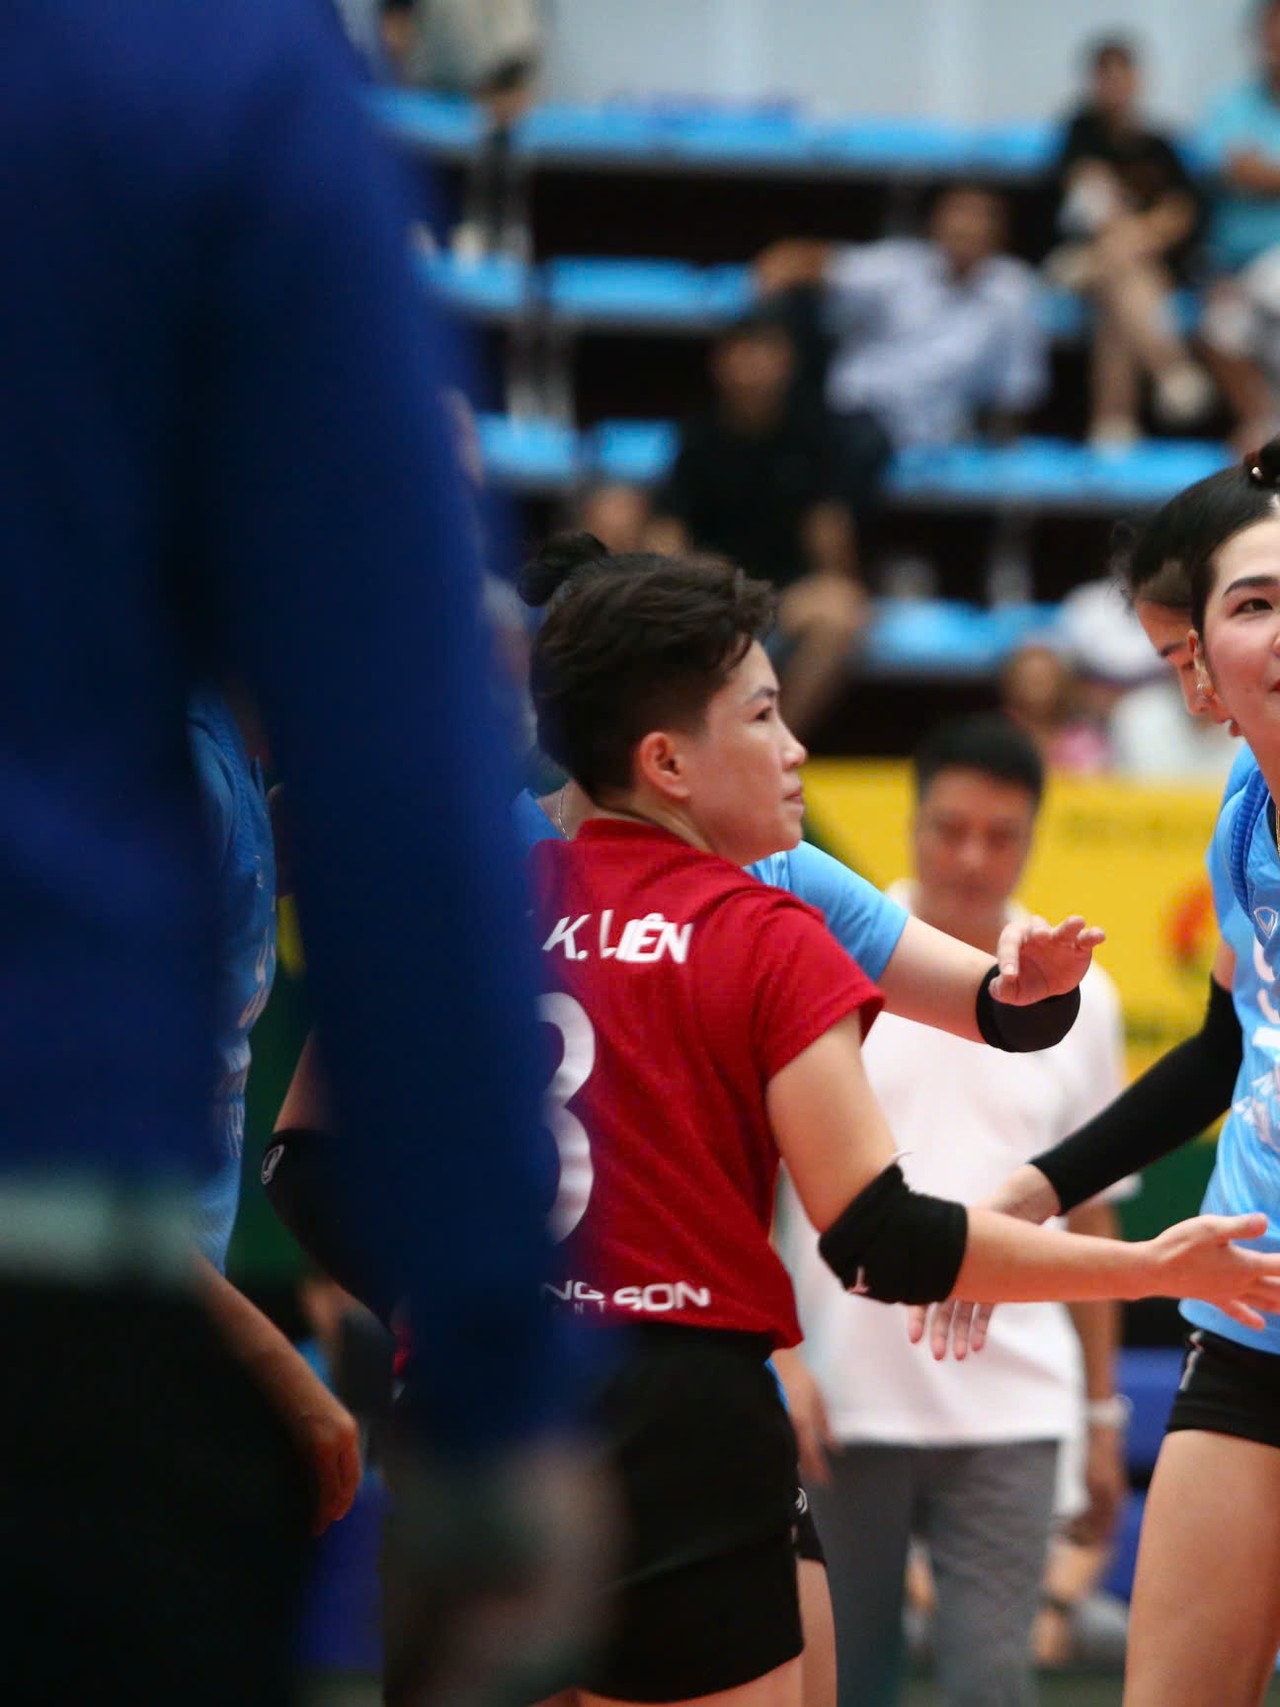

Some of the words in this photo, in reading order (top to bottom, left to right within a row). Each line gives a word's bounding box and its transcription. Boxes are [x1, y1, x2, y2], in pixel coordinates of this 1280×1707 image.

[542, 913, 592, 961] K.
[599, 909, 694, 964] LIÊN
[540, 1279, 605, 1300] NG
[612, 1280, 712, 1312] SON
